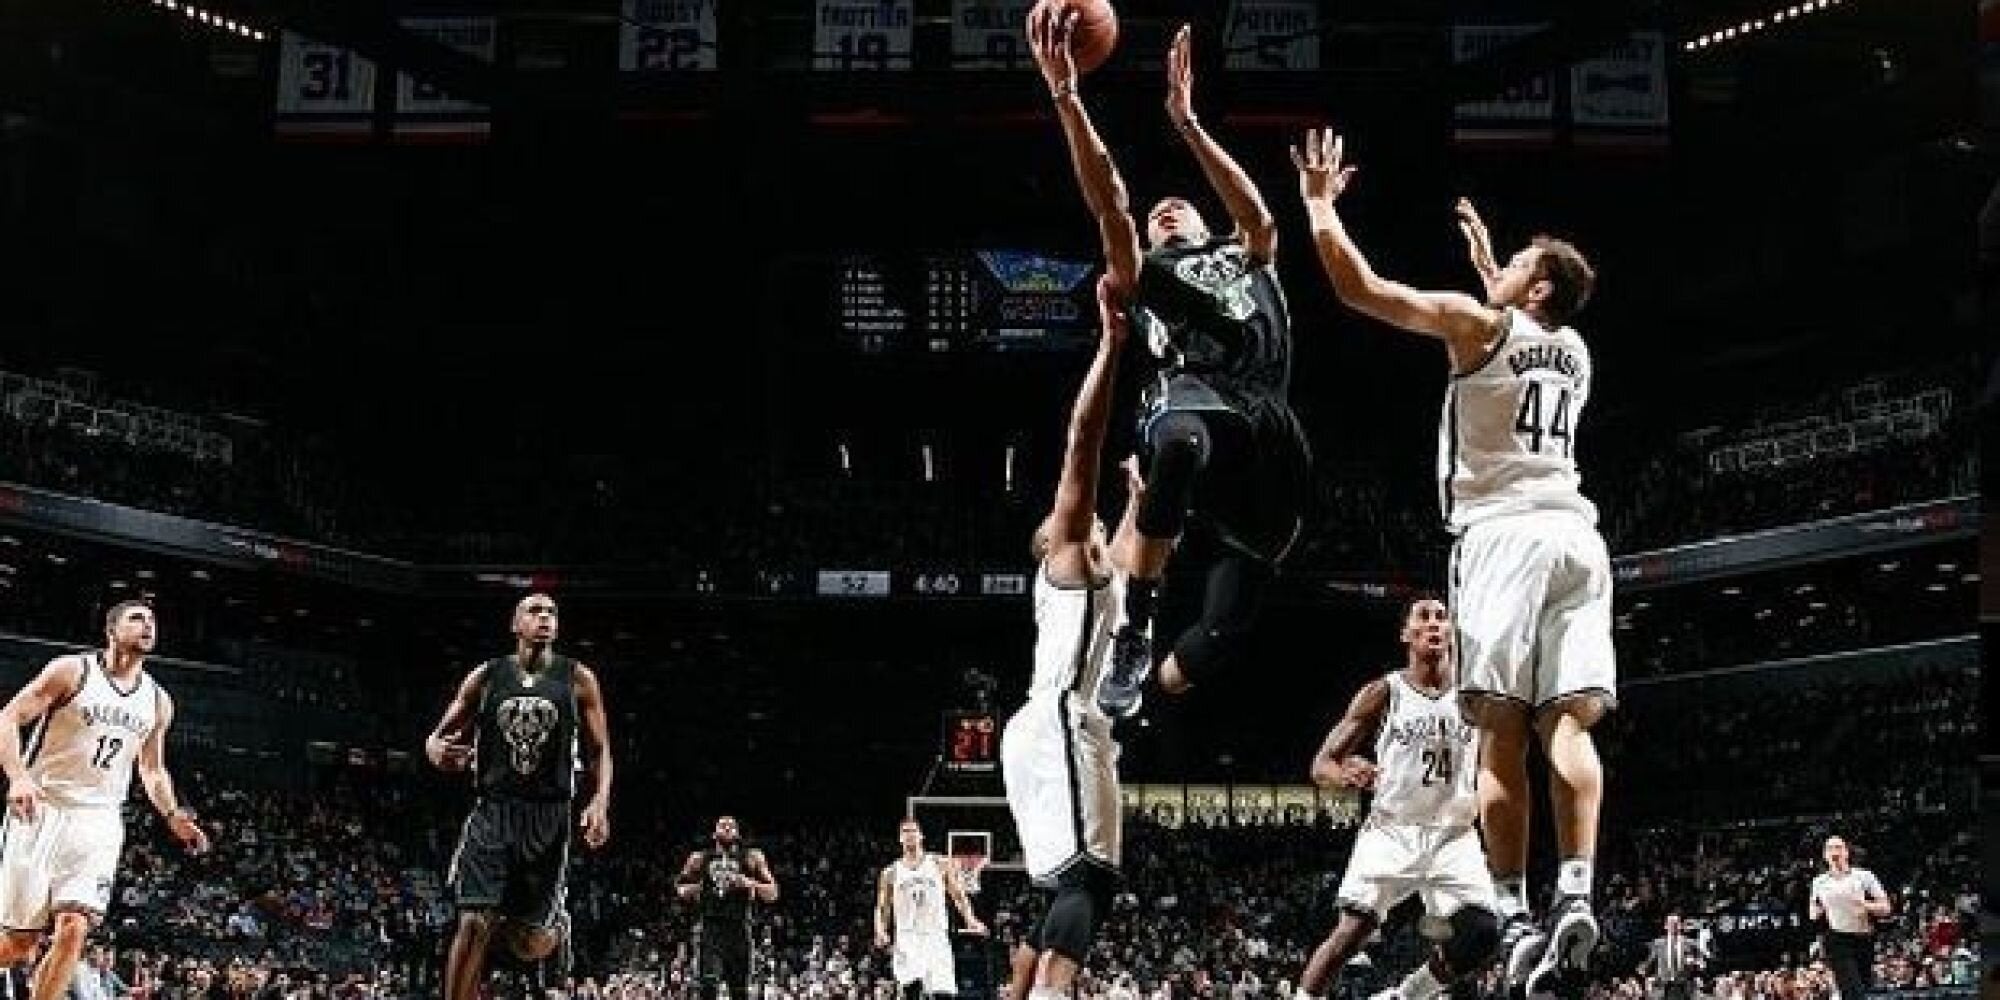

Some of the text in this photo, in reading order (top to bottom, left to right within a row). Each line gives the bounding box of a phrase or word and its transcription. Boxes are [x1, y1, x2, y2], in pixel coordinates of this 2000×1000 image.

[301, 53, 349, 100] 31
[1515, 379, 1572, 459] 44
[92, 735, 124, 769] 12
[955, 731, 990, 759] 21
[1421, 748, 1454, 787] 24
